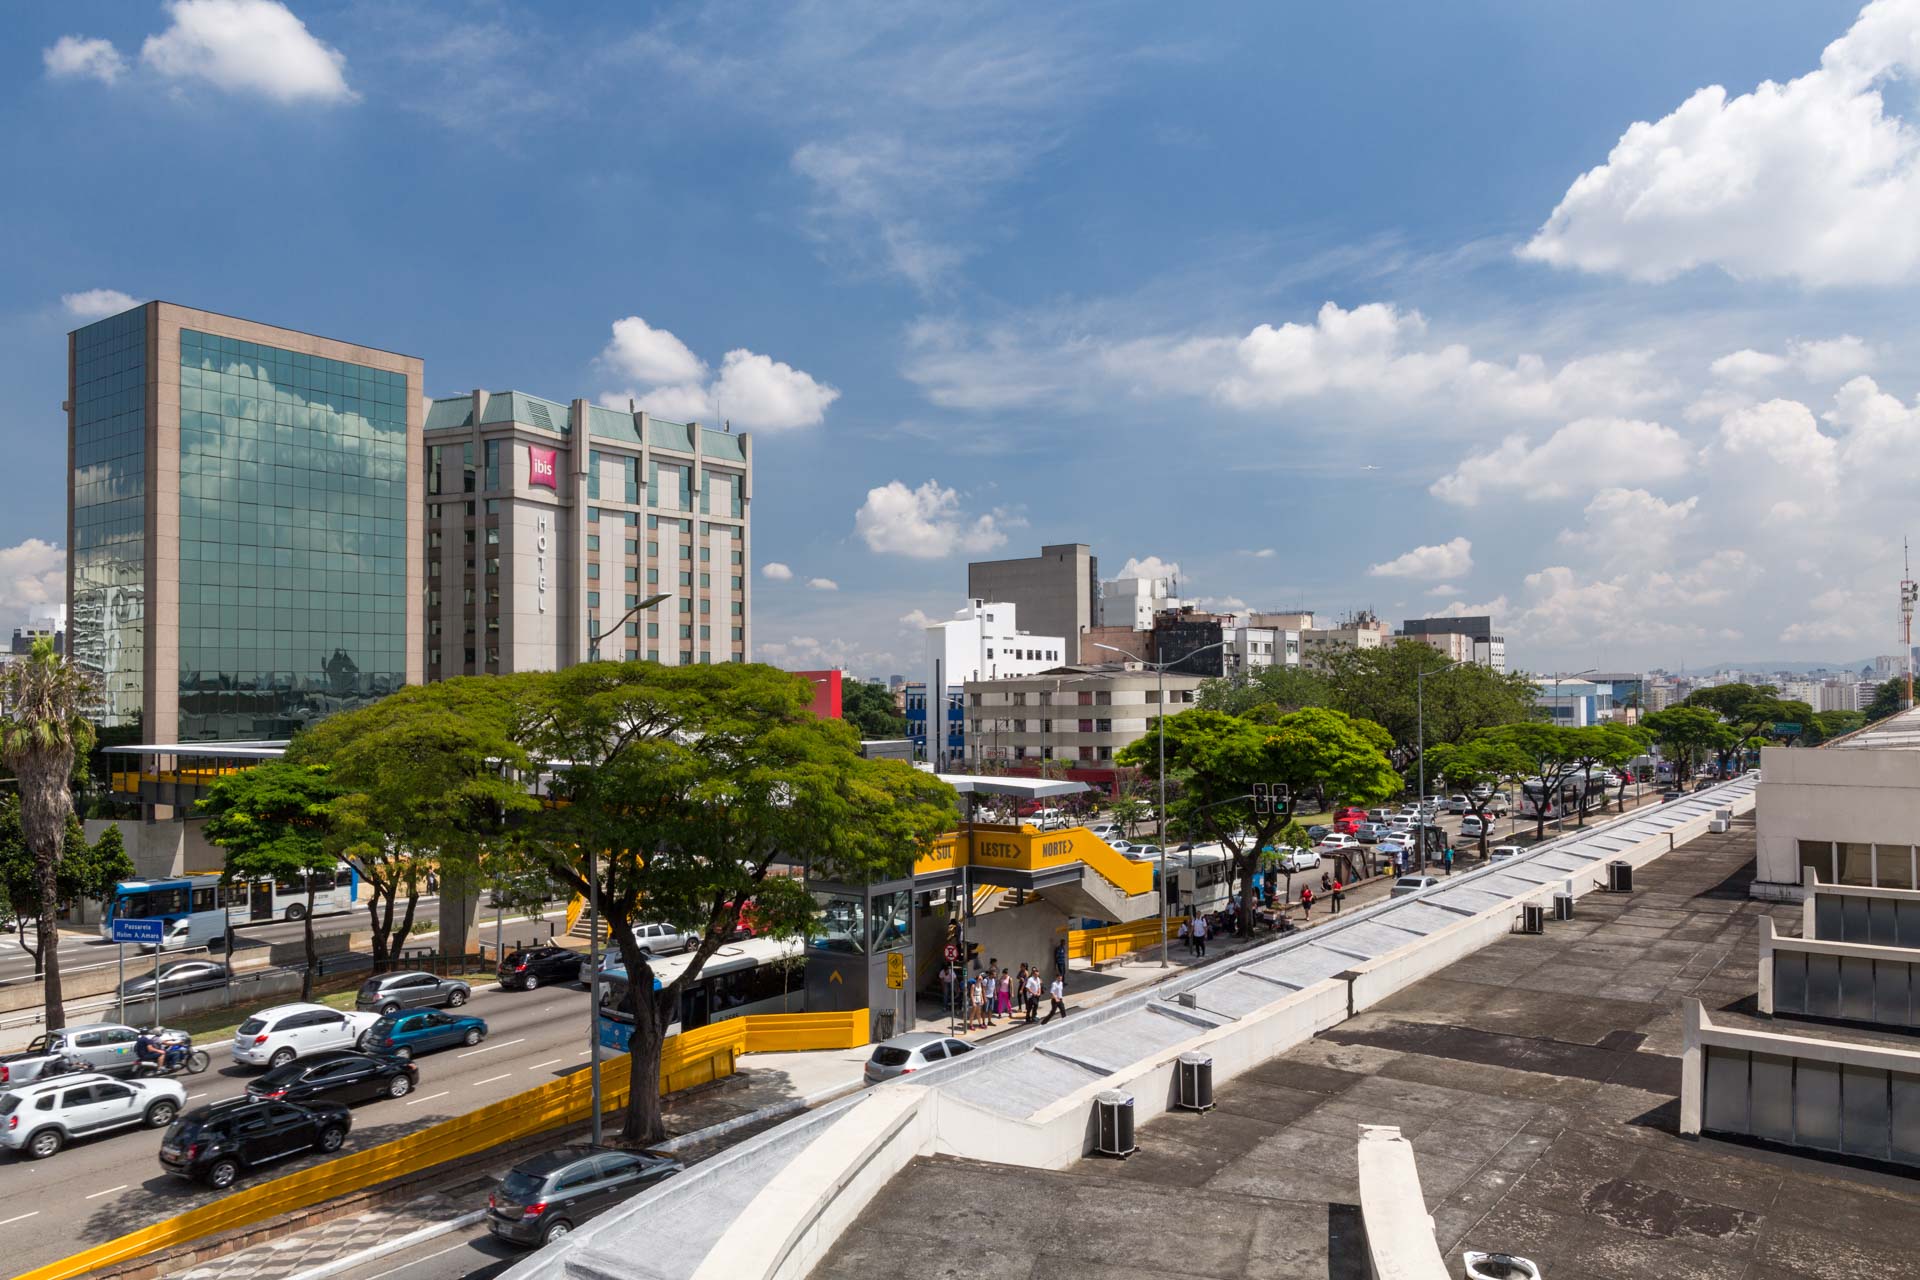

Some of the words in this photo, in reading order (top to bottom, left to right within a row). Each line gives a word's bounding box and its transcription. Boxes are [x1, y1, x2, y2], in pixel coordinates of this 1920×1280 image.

[534, 458, 552, 476] ibis
[537, 515, 547, 614] HOTEL
[936, 844, 952, 860] SUL
[980, 841, 1011, 859] LESTE
[1042, 841, 1067, 858] NORTE
